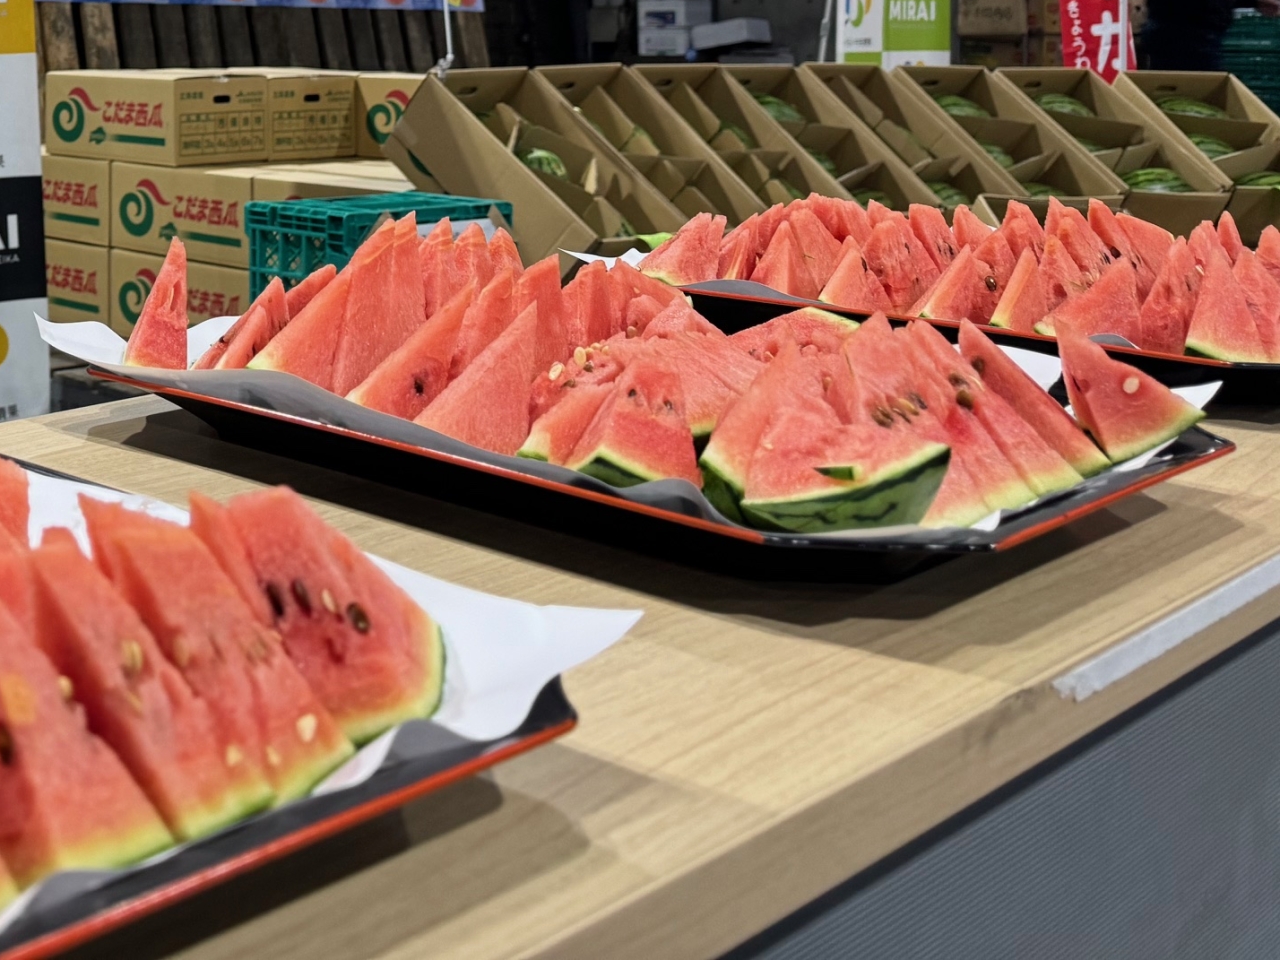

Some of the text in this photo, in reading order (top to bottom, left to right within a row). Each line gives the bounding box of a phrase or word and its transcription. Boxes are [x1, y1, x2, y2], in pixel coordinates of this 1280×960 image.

[889, 0, 936, 21] MIRAI
[102, 100, 164, 128] こだま西瓜
[173, 195, 240, 229] こだま西瓜
